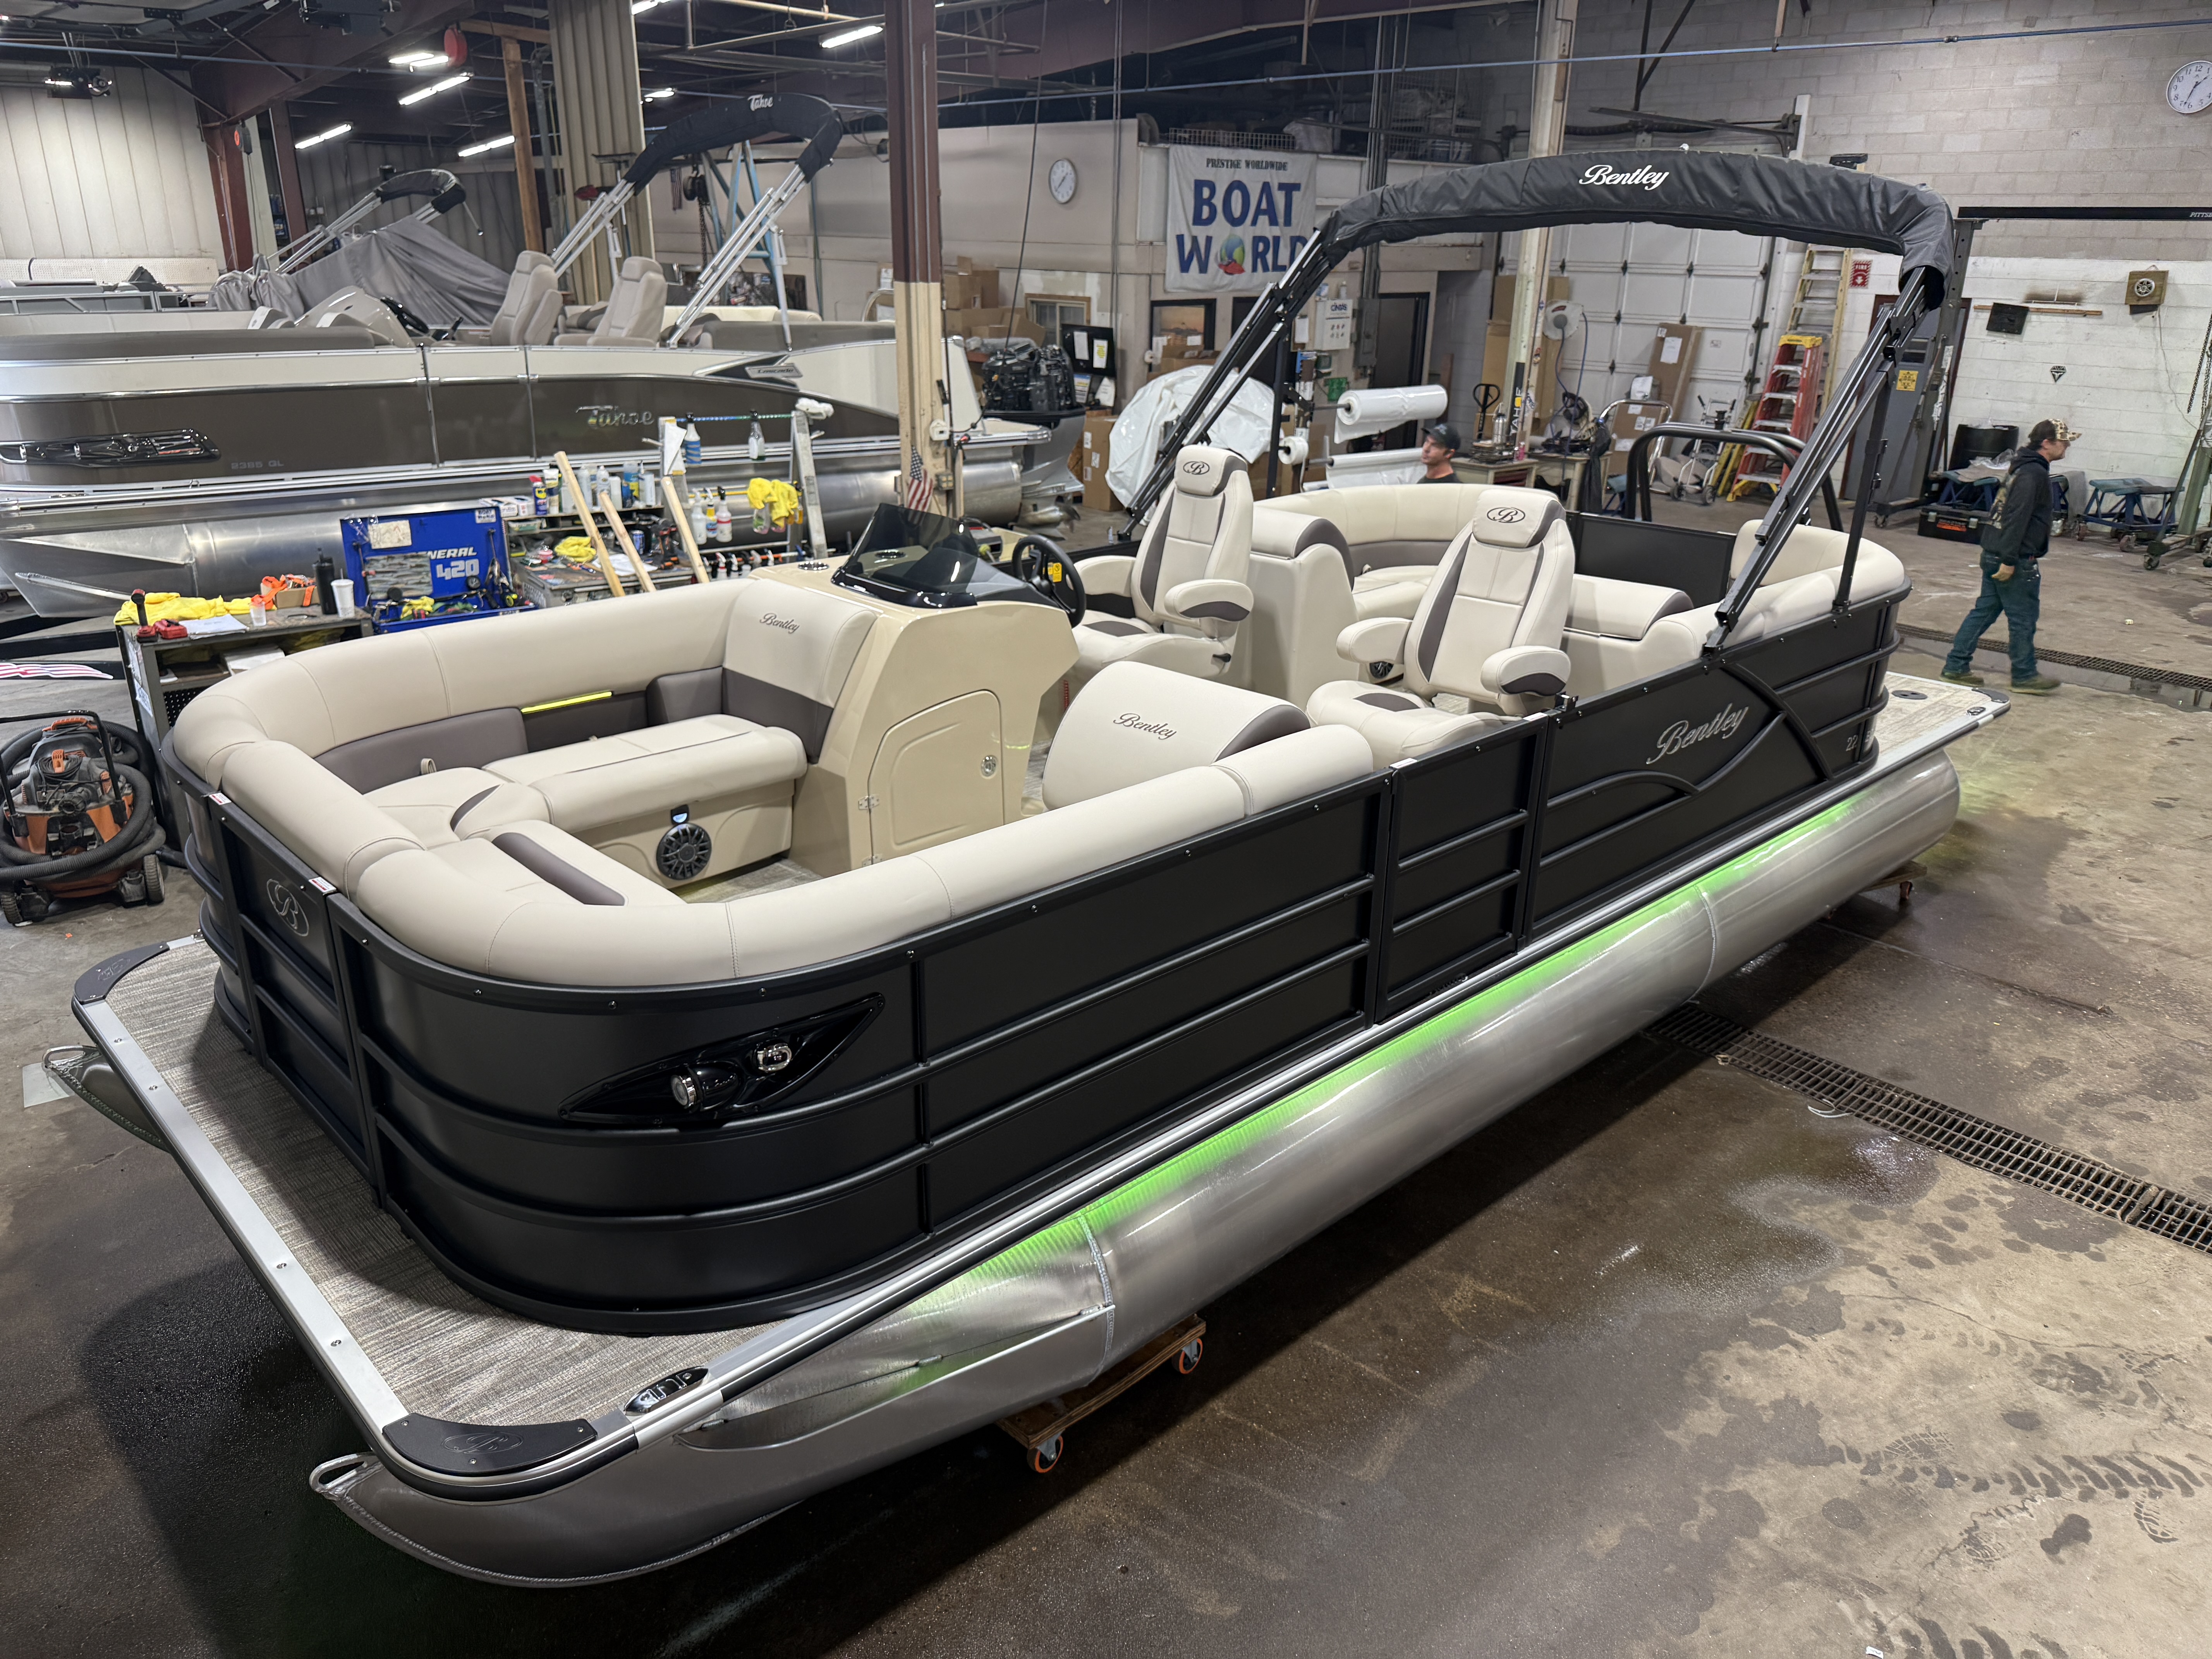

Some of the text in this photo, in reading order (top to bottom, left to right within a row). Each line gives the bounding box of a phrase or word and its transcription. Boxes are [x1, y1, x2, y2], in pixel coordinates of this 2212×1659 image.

[747, 94, 773, 111] Tahoe
[1206, 158, 1288, 171] PRESTIGE WORLDWIDE
[1579, 165, 1669, 191] Bentley
[1192, 179, 1301, 227] BOAT
[575, 405, 655, 430] Tahoe
[436, 559, 480, 580] 420
[759, 613, 800, 634] Bentley
[1113, 713, 1177, 740] Bentley
[1646, 703, 1749, 764] Bentley
